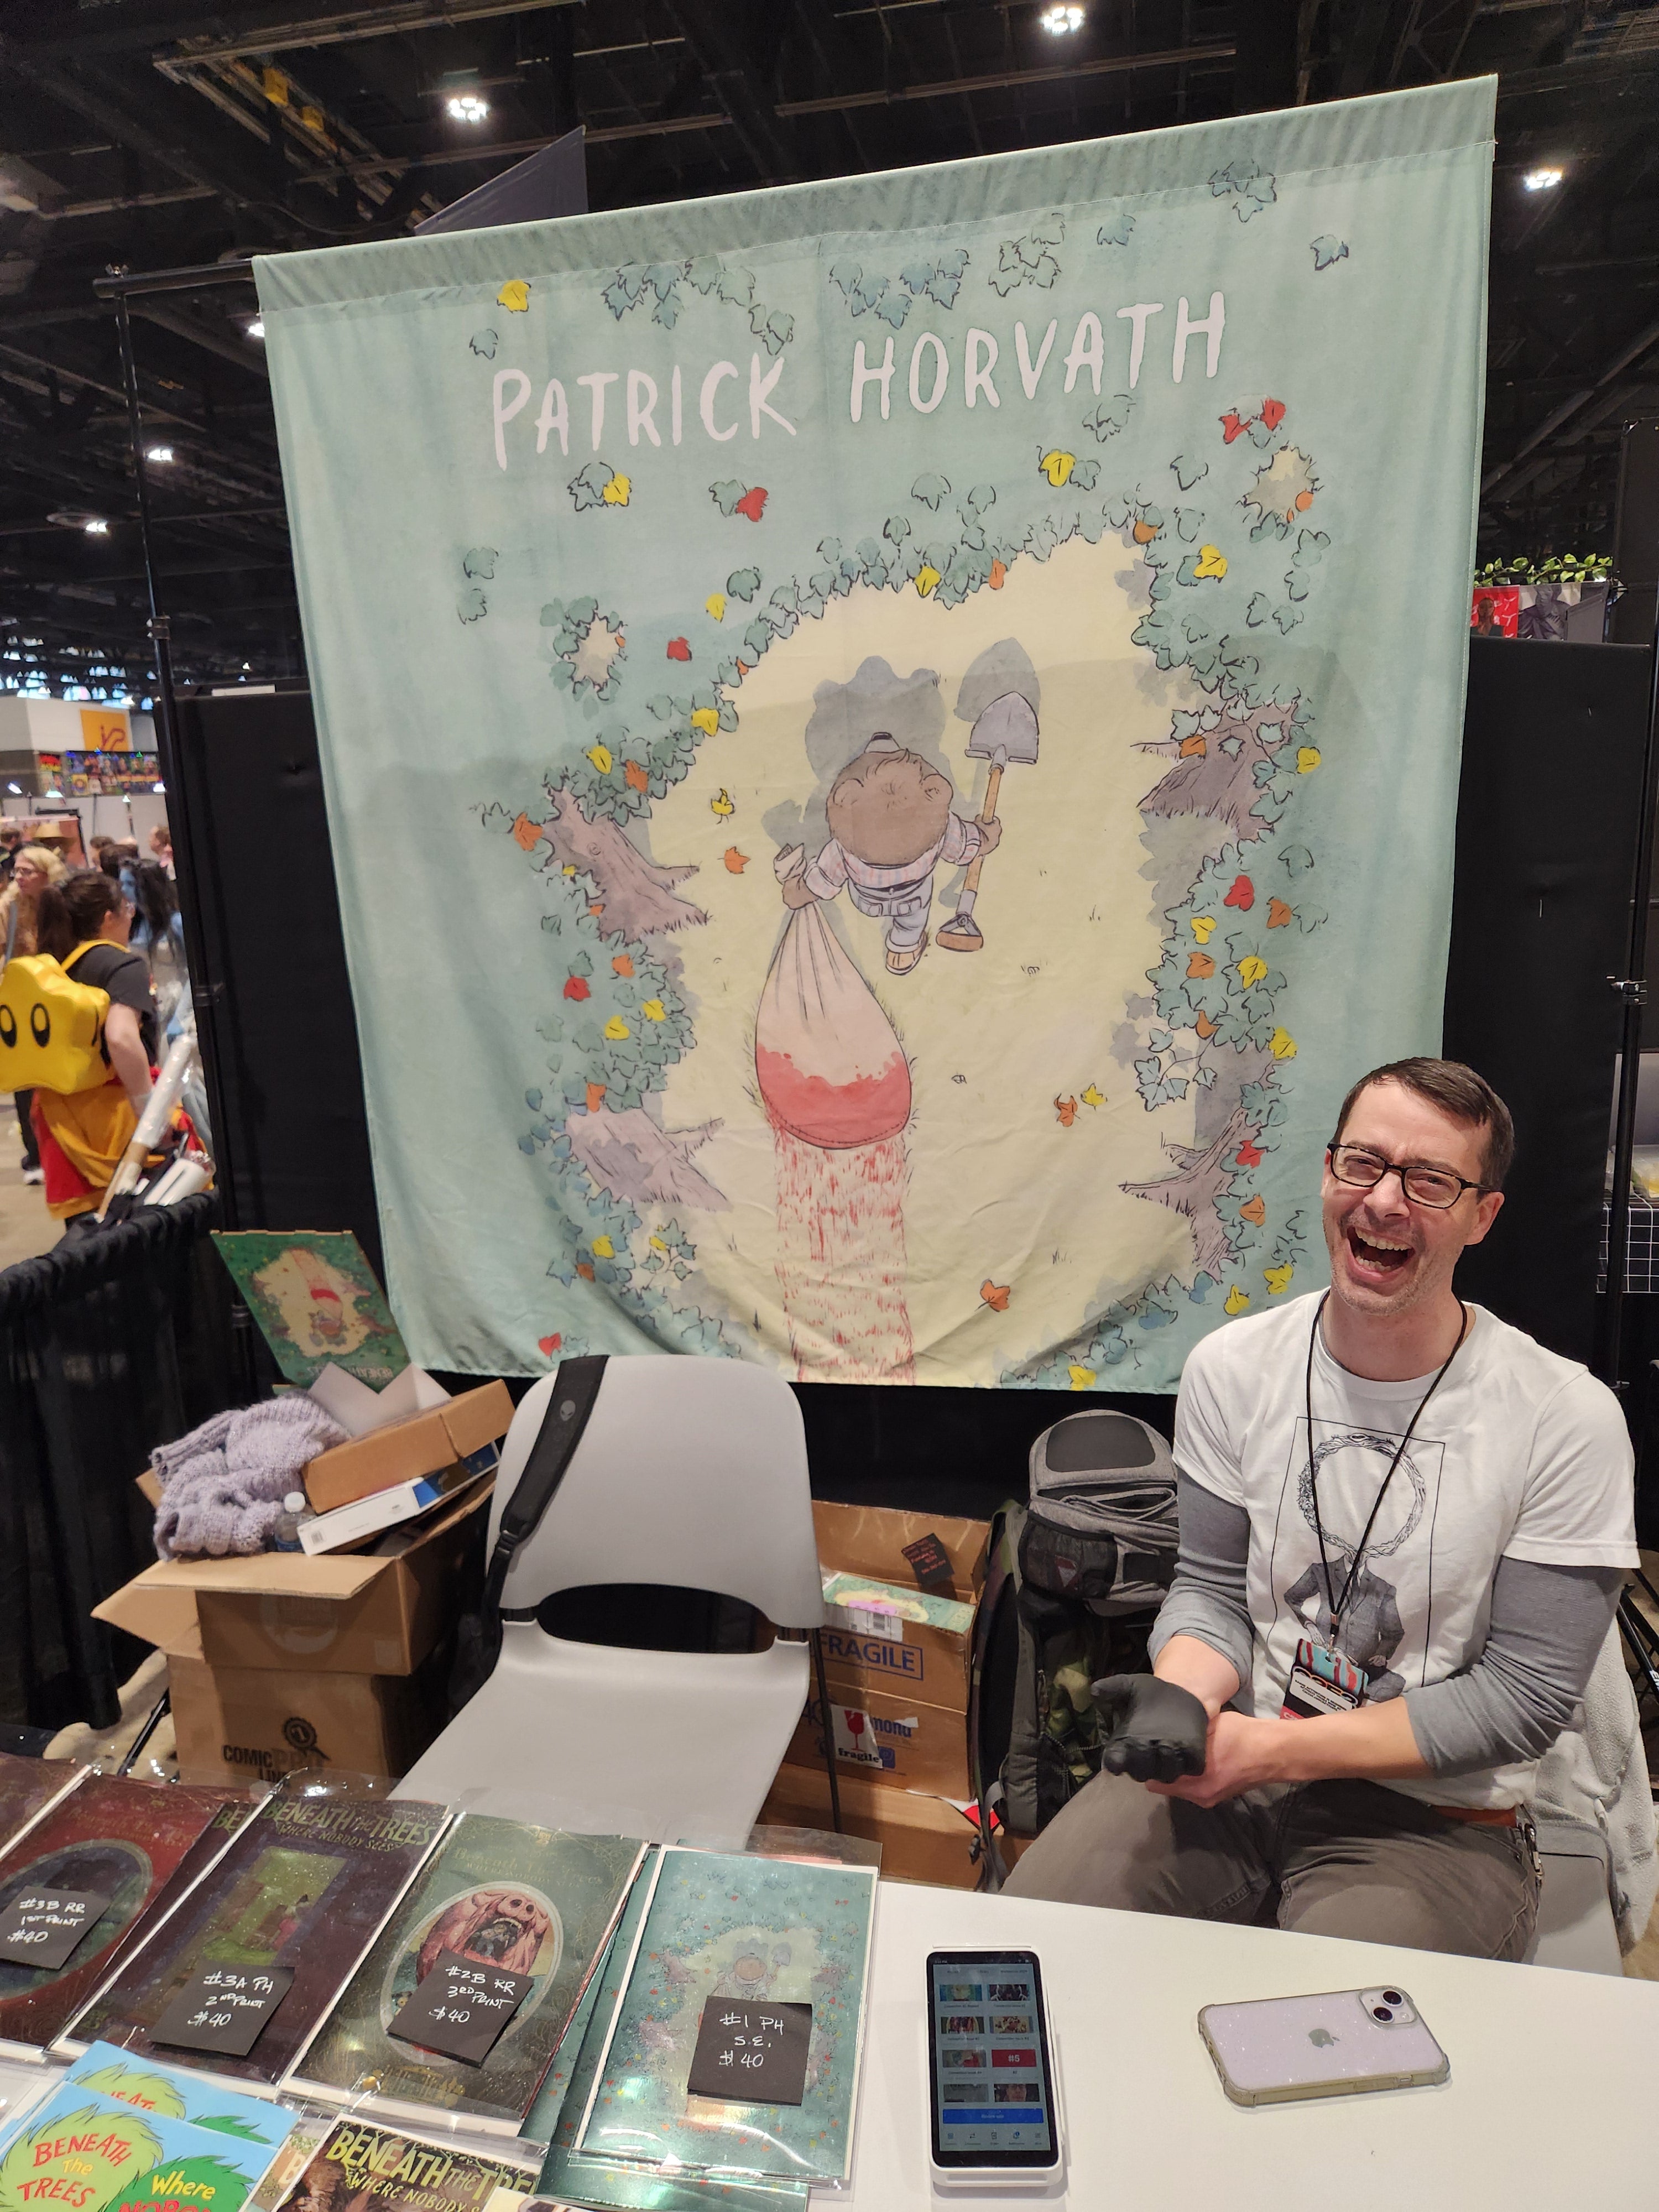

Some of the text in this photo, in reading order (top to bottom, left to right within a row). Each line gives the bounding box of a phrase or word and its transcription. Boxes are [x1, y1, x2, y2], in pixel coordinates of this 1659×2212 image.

[493, 291, 1225, 471] PATRICK HORVATH
[223, 1744, 273, 1768] COMIC
[838, 1747, 880, 1763] fragile
[260, 1799, 357, 1830] BENEATH
[369, 1815, 439, 1846] TREES
[281, 1824, 316, 1839] WHERE
[319, 1829, 364, 1849] NOBODY
[19, 1897, 85, 1914] #3B RR
[203, 1970, 274, 1995] #3A PH
[445, 1965, 515, 1996] #2B RR
[233, 1995, 266, 2009] PRINT
[447, 1986, 514, 2009] 3RD PRINT
[719, 2012, 784, 2035] #1 PH
[33, 2133, 132, 2167] BENEATH
[326, 2129, 453, 2188] BENEATH
[445, 2168, 482, 2192] THE
[62, 2157, 93, 2176] The
[17, 2177, 96, 2208] TREES
[152, 2170, 216, 2200] Where
[351, 2171, 467, 2212] WHERE NOBODY
